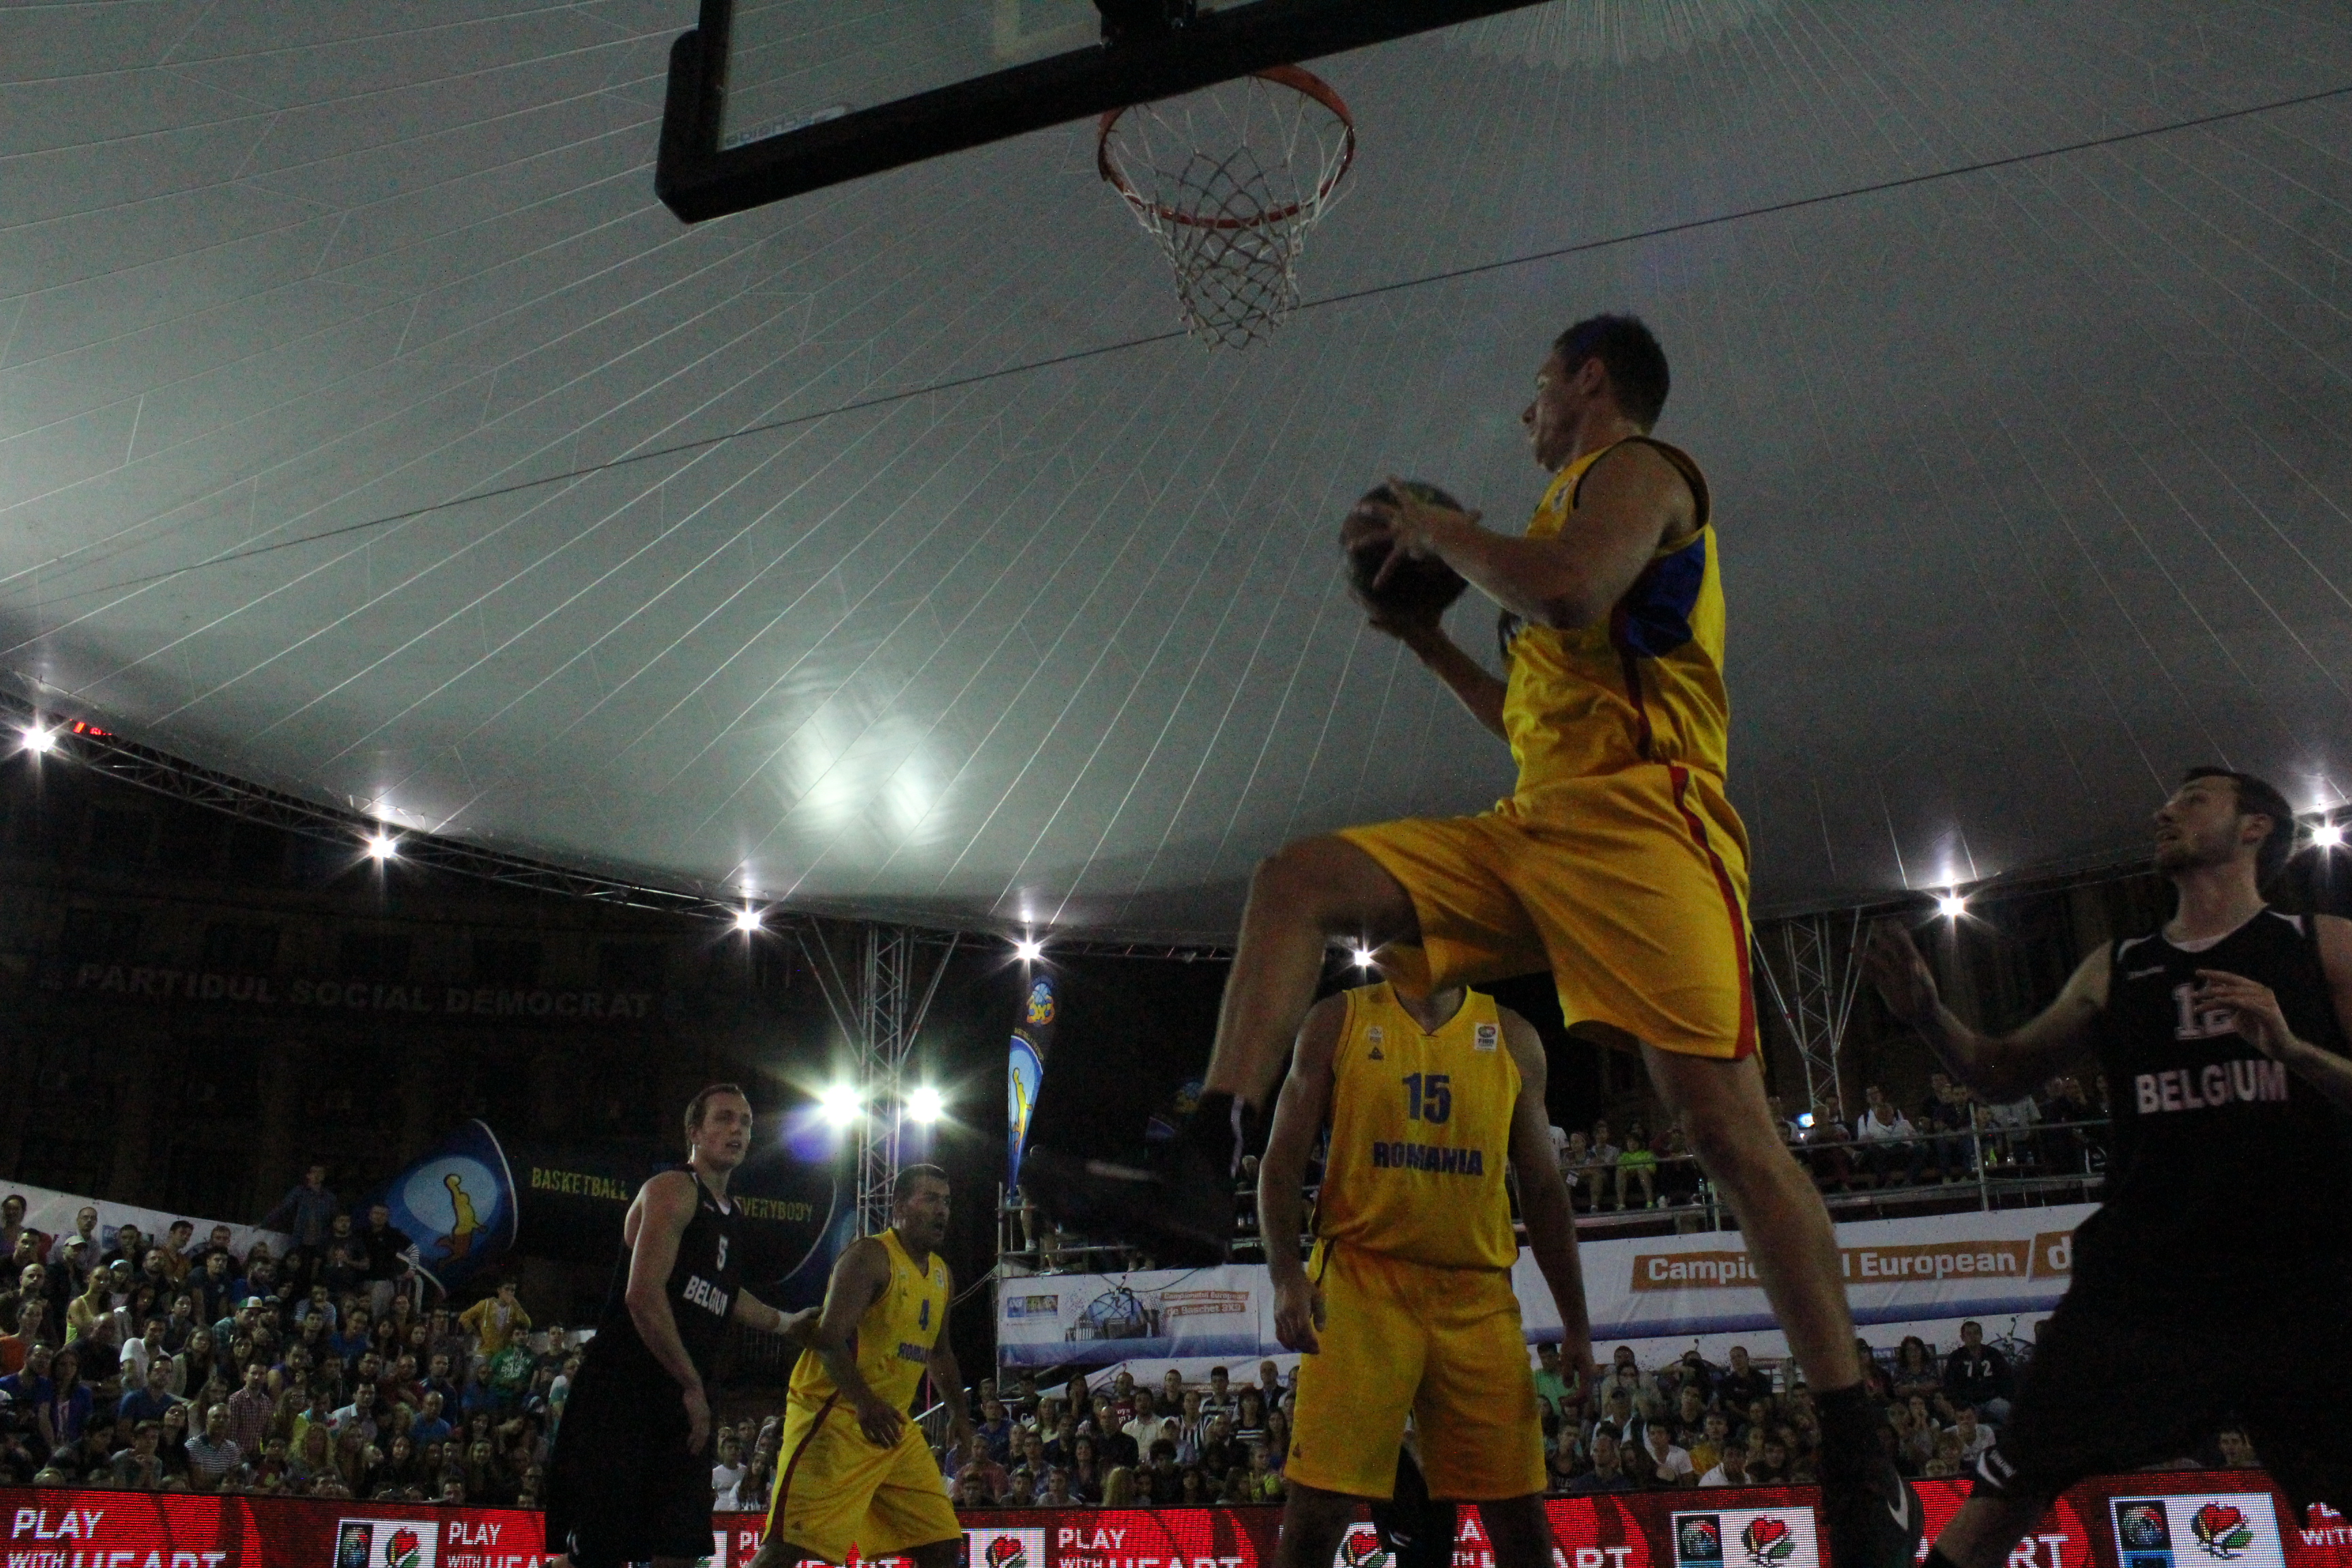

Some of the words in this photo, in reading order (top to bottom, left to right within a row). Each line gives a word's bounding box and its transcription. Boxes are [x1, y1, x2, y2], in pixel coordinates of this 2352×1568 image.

[76, 962, 277, 1004] PARTIDUL
[290, 978, 431, 1014] SOCIAL
[446, 987, 653, 1019] DEMOCRAT
[1403, 1073, 1452, 1124] 15
[2134, 1059, 2289, 1115] BELGIUM
[1373, 1141, 1483, 1176] ROMANIA
[530, 1166, 630, 1202] BASKETBALL
[716, 1234, 730, 1271] 5
[1860, 1250, 2016, 1280] European
[919, 1298, 930, 1330] 4
[11, 1507, 104, 1539] PLAY
[448, 1521, 502, 1545] PLAY
[1058, 1528, 1126, 1548] PLAY
[2299, 1526, 2352, 1546] WIT
[7, 1552, 67, 1568] WITH
[447, 1554, 481, 1568] WITH
